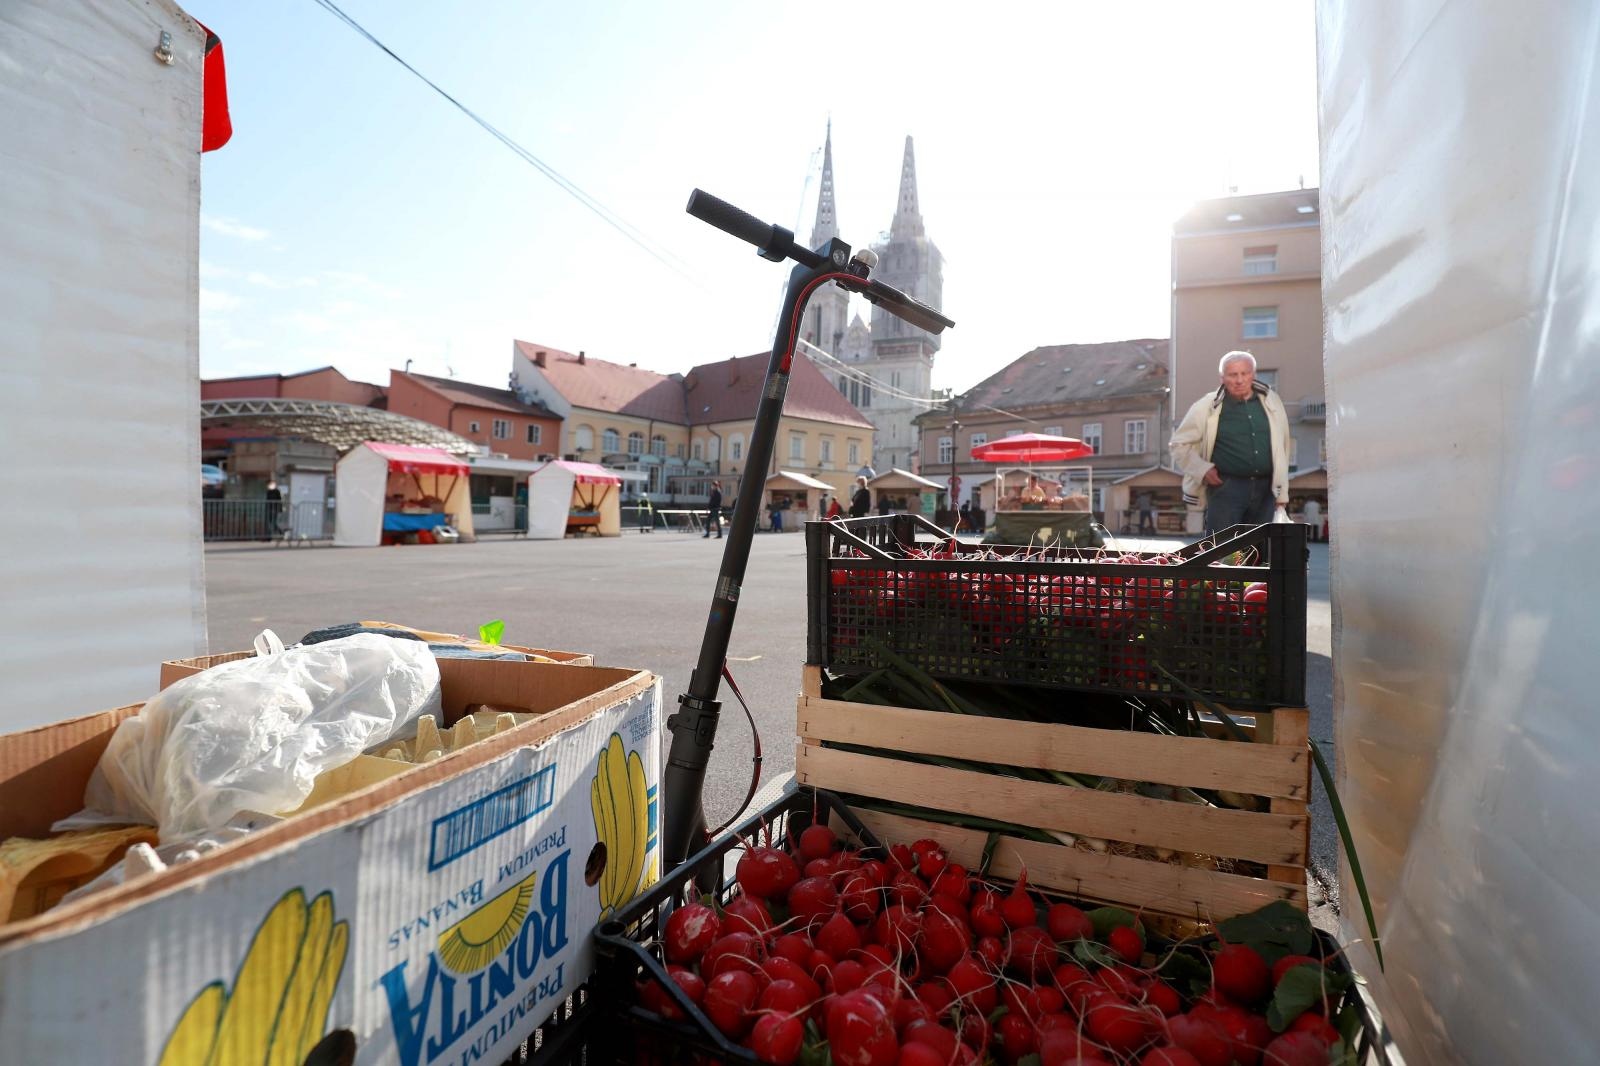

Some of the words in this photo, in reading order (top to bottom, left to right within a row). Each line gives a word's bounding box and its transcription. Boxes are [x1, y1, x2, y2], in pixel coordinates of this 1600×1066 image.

[498, 824, 567, 883] PREMIUM
[379, 848, 571, 1066] BONITA
[388, 878, 484, 950] BANANAS
[460, 962, 565, 1066] PREMIUM
